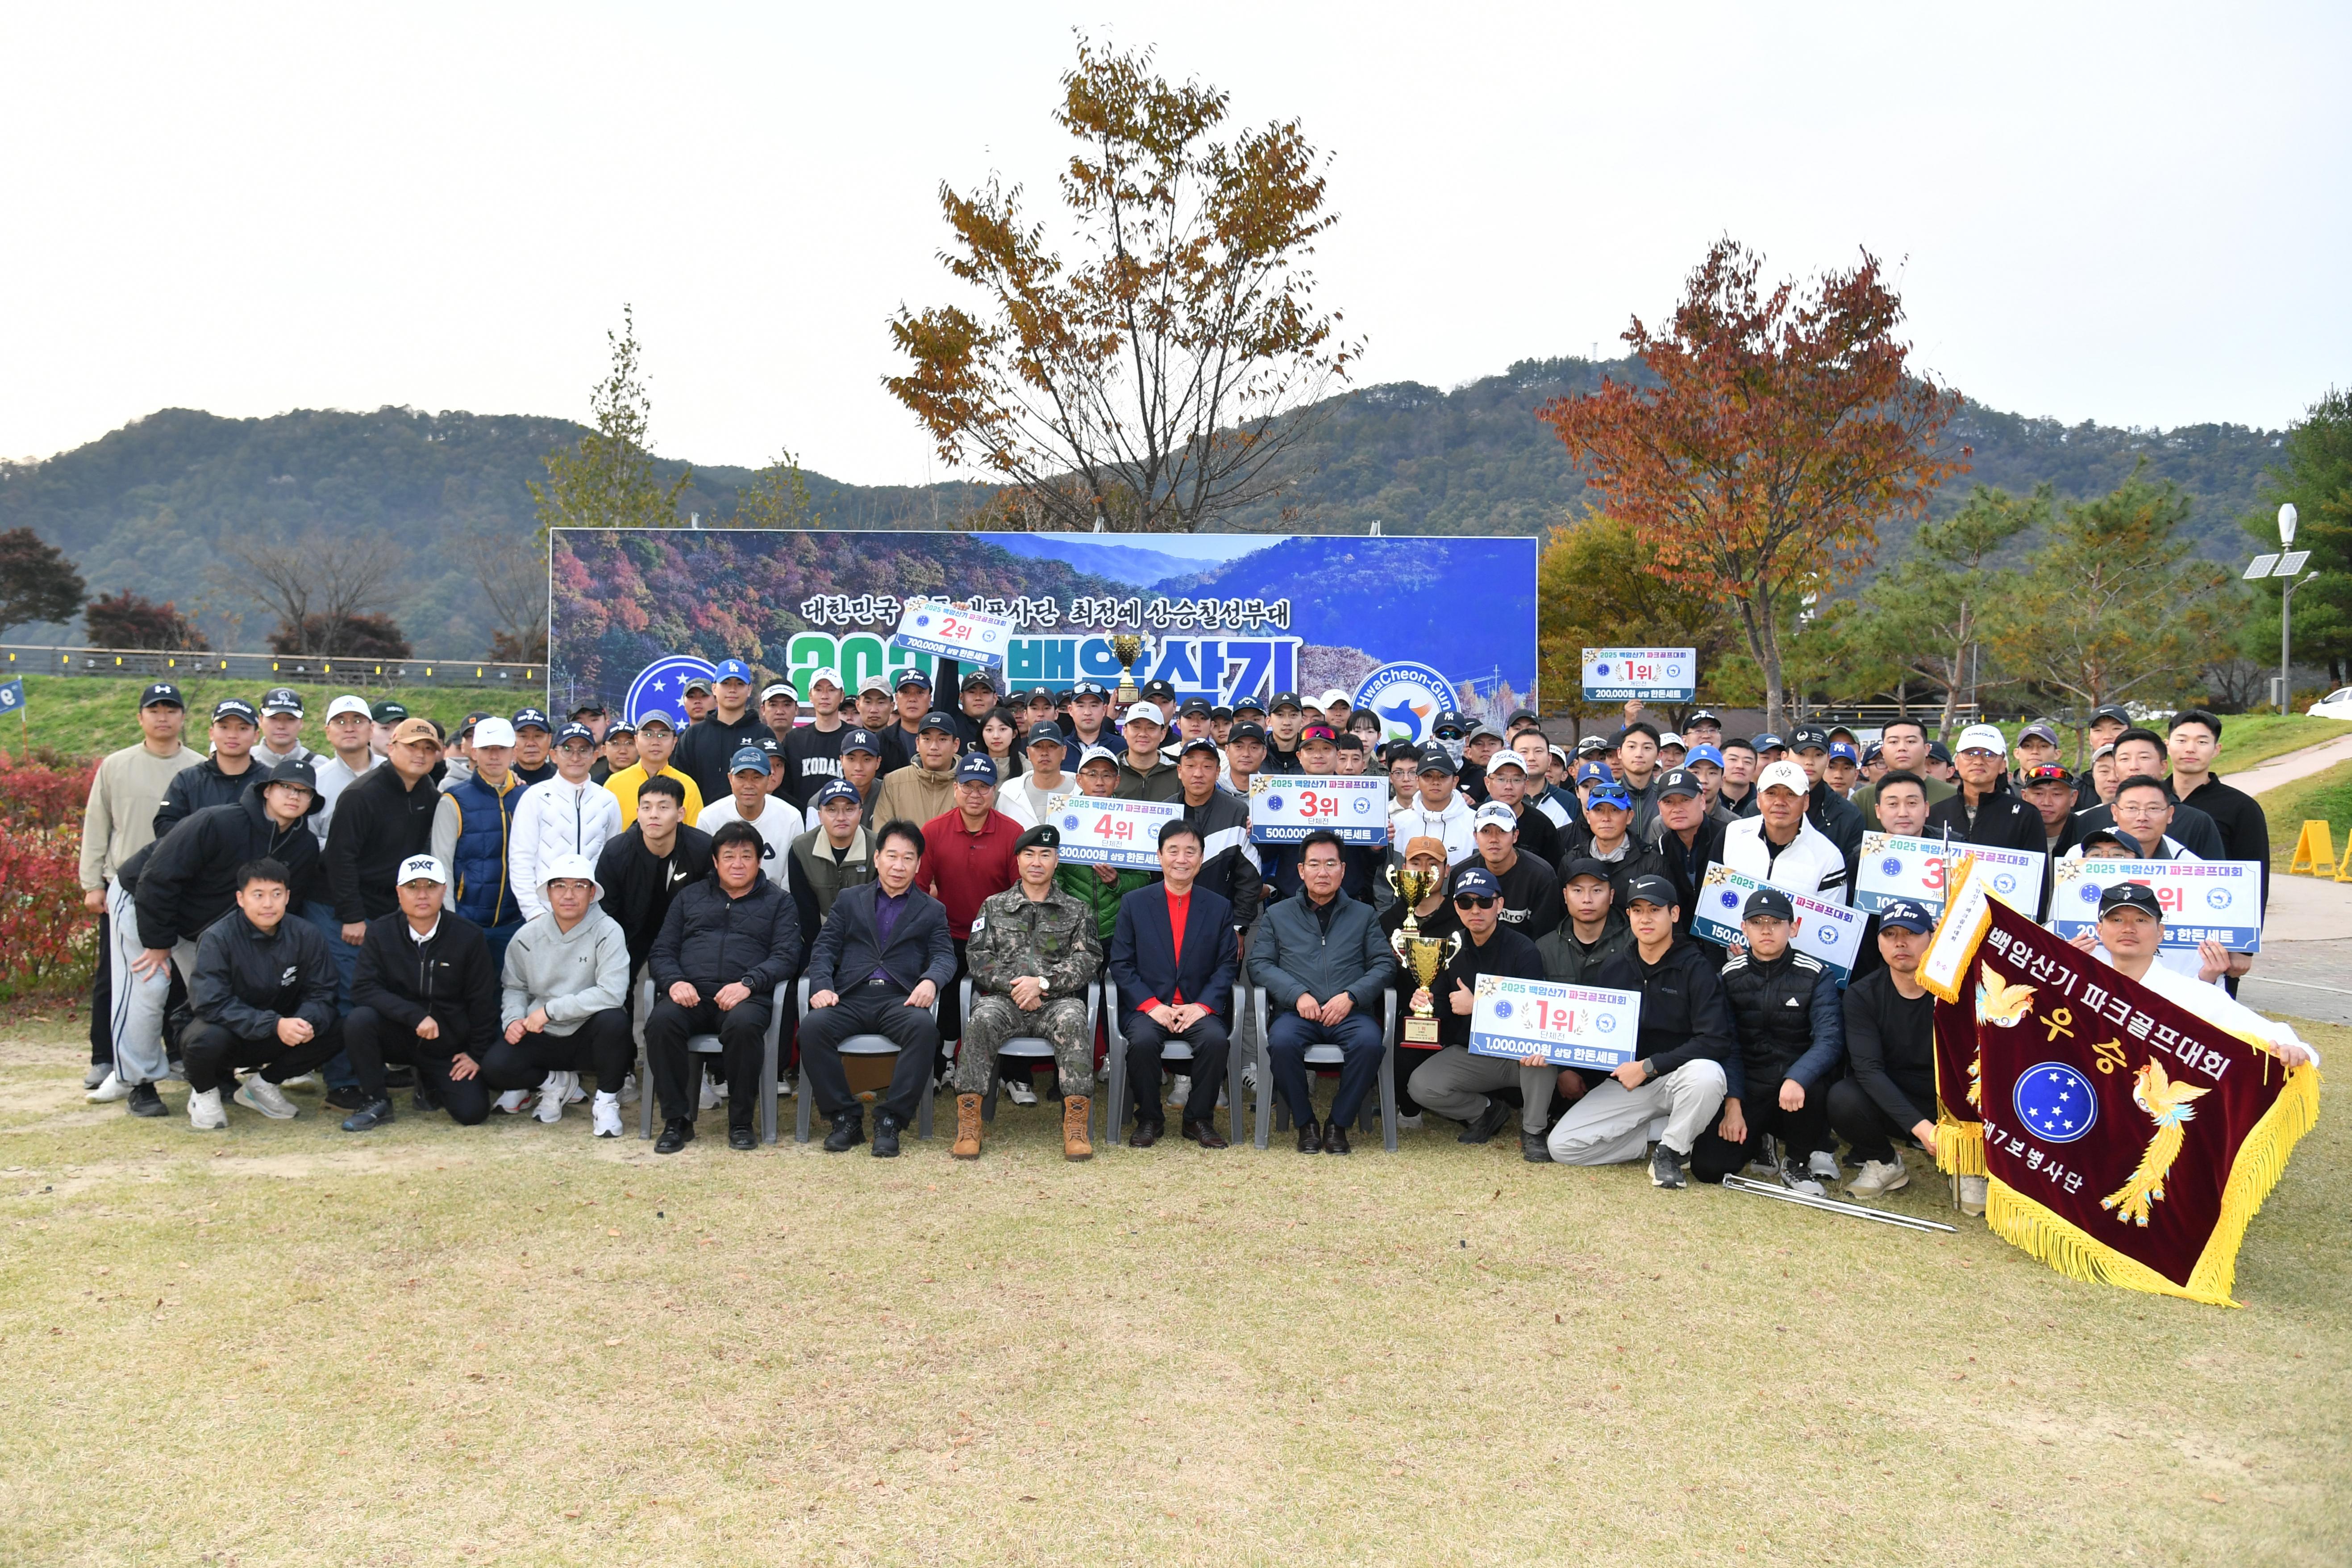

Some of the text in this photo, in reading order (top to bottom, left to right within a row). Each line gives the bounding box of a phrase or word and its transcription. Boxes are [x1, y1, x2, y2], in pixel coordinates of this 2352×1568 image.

[803, 596, 898, 624] 대한민국
[1072, 599, 1141, 626] 최정예
[1145, 599, 1290, 628] 상승칠성부대
[924, 604, 1007, 627] 2025 백암산기 파크골프대회
[939, 618, 972, 641] 2위
[907, 637, 946, 653] 700,000원
[960, 649, 990, 662] 한돈세트
[728, 661, 739, 673] LA
[1625, 661, 1652, 680] 1위
[969, 671, 990, 679] Callaway
[1357, 669, 1452, 711] HwaCheon-Gun
[1595, 689, 1636, 699] 200,000원
[1650, 689, 1681, 699] 한돈세트
[1444, 712, 1454, 721] NY
[855, 732, 866, 744] NY
[1427, 741, 1437, 750] NY
[1833, 743, 1846, 753] NY
[1589, 763, 1600, 774] LA
[1271, 779, 1378, 789] 2025 백암산기 파크골프대회
[1069, 799, 1173, 816] 2025 백암산기 파크골프대회
[1299, 791, 1338, 817] 3위
[1094, 814, 1133, 840] 4위
[1307, 817, 1329, 825] 단체전
[1102, 840, 1123, 848] 단체전
[1890, 840, 1917, 852] 2025
[1059, 846, 1108, 861] 300,000원
[1110, 853, 1125, 862] 상당
[2086, 864, 2243, 877] 2025 백암산기 파크골프대회
[1730, 874, 1755, 890] 2025
[1795, 896, 1854, 923] 파크골프대회
[2177, 928, 2234, 943] 한돈세트
[1501, 982, 1627, 1005] 2025 백암산기 파크골프대회
[1988, 926, 2231, 1082] 백암산기 파크골프대회
[1536, 1000, 1574, 1032] 1위
[1540, 1031, 1565, 1041] 단체전
[1485, 1036, 1619, 1065] 1,000,000원 상당 한돈세트
